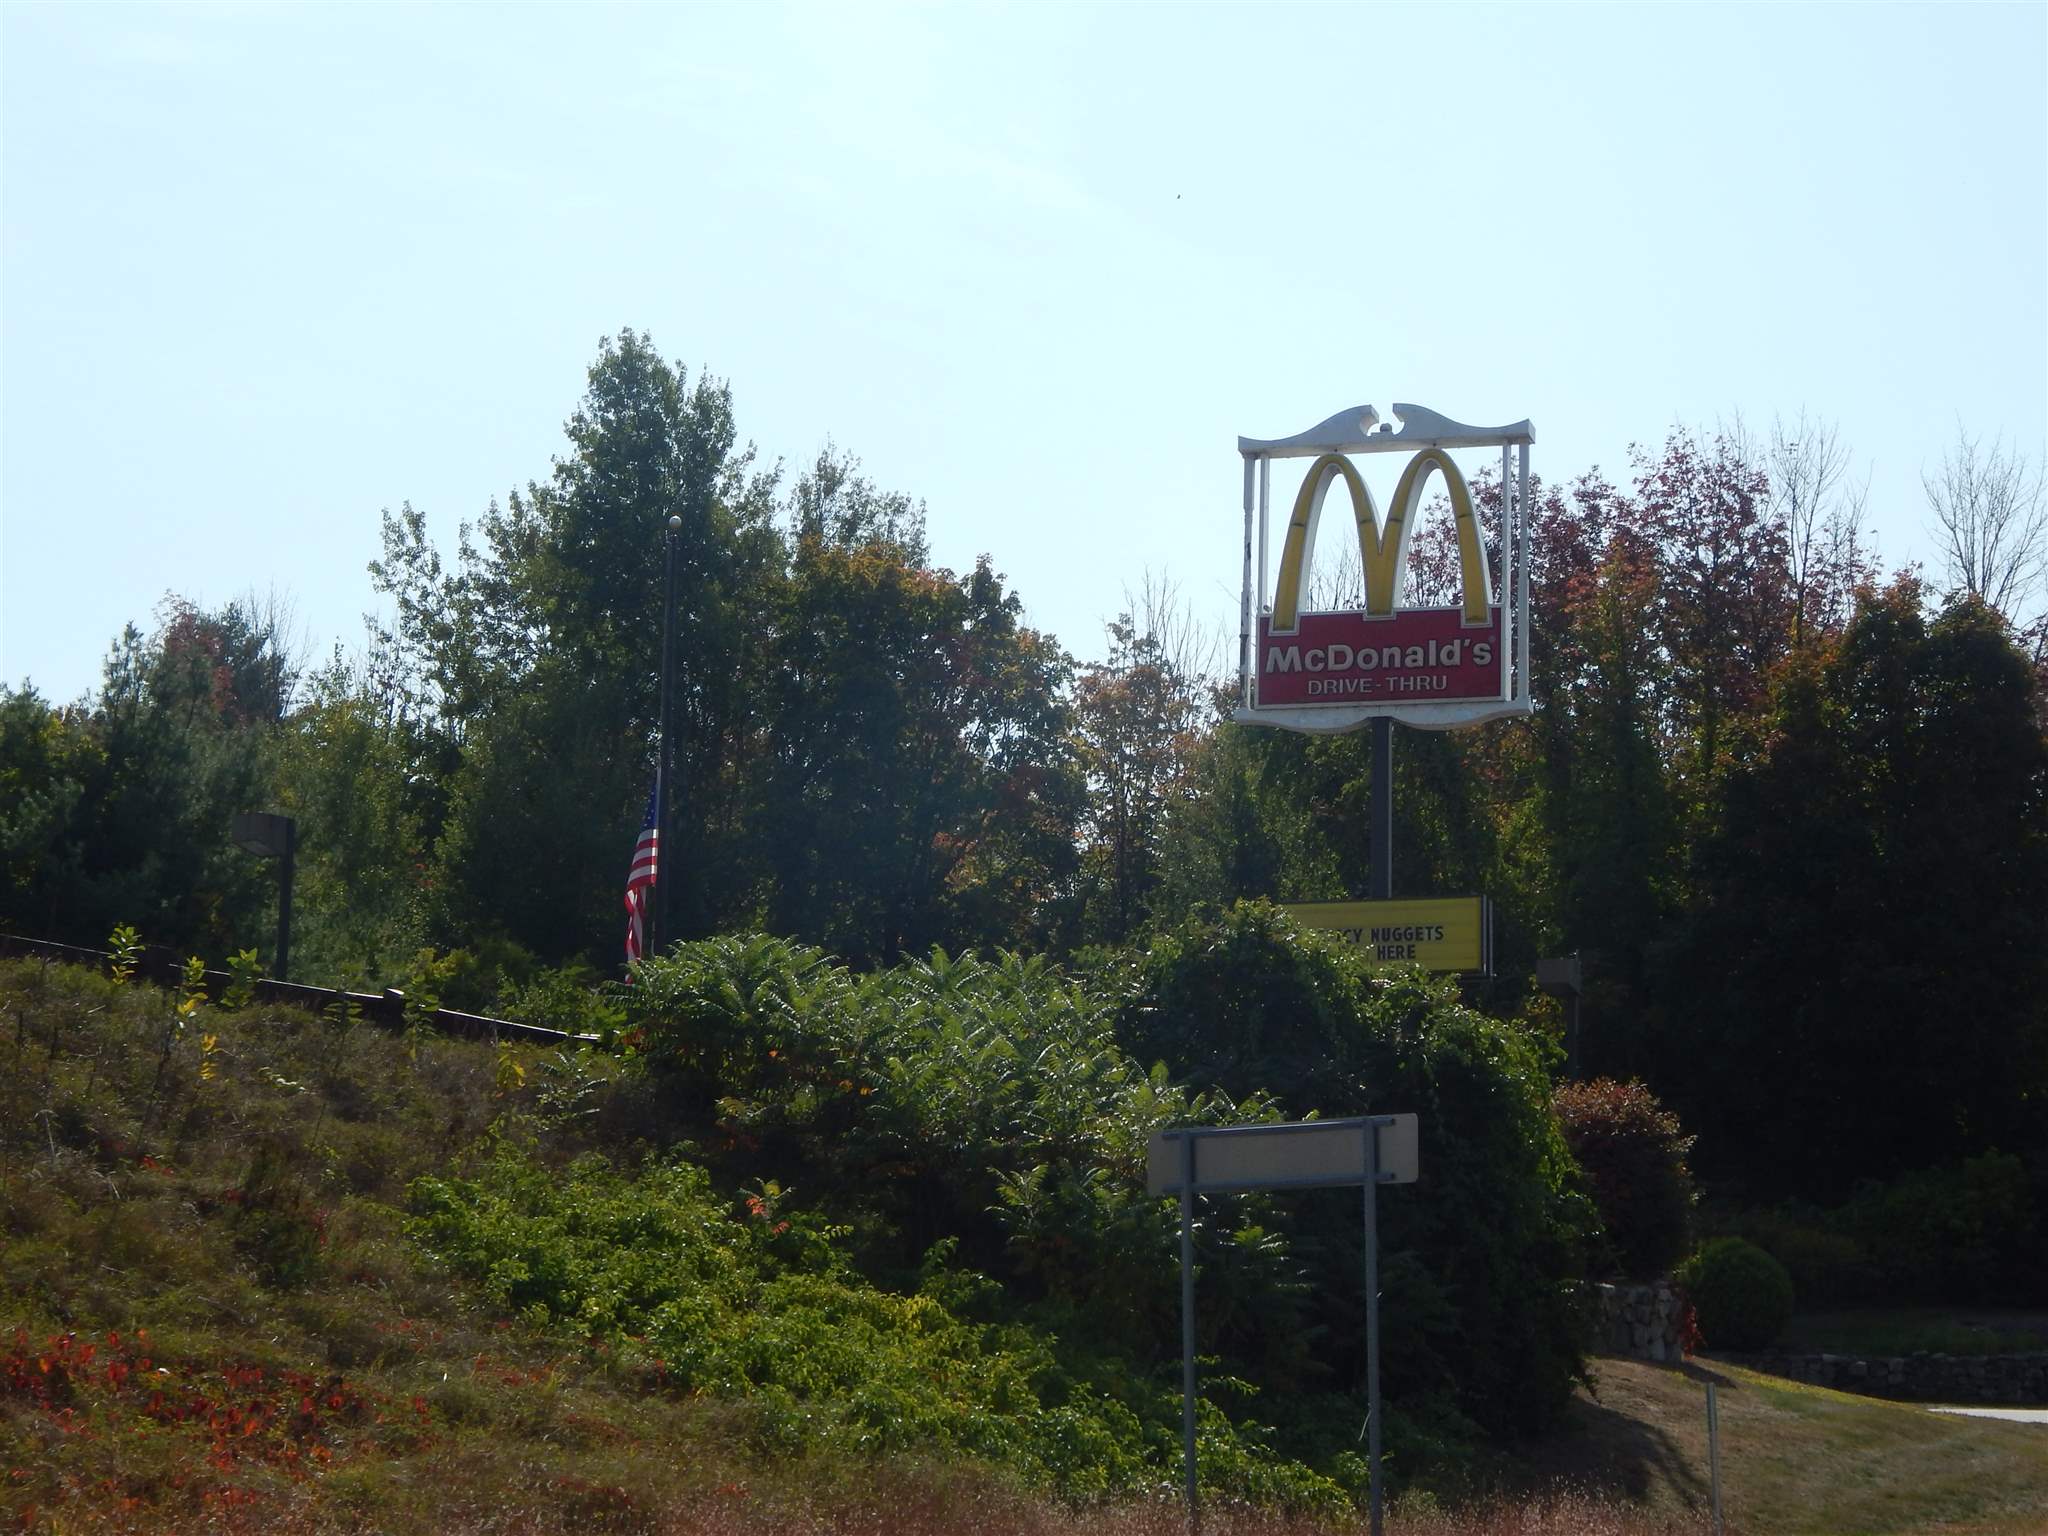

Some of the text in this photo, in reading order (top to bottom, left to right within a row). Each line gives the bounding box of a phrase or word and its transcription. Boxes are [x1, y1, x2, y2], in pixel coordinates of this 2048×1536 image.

[1265, 638, 1492, 673] McDonald's
[1370, 925, 1444, 943] NUGGETS
[1377, 944, 1416, 960] HERE
